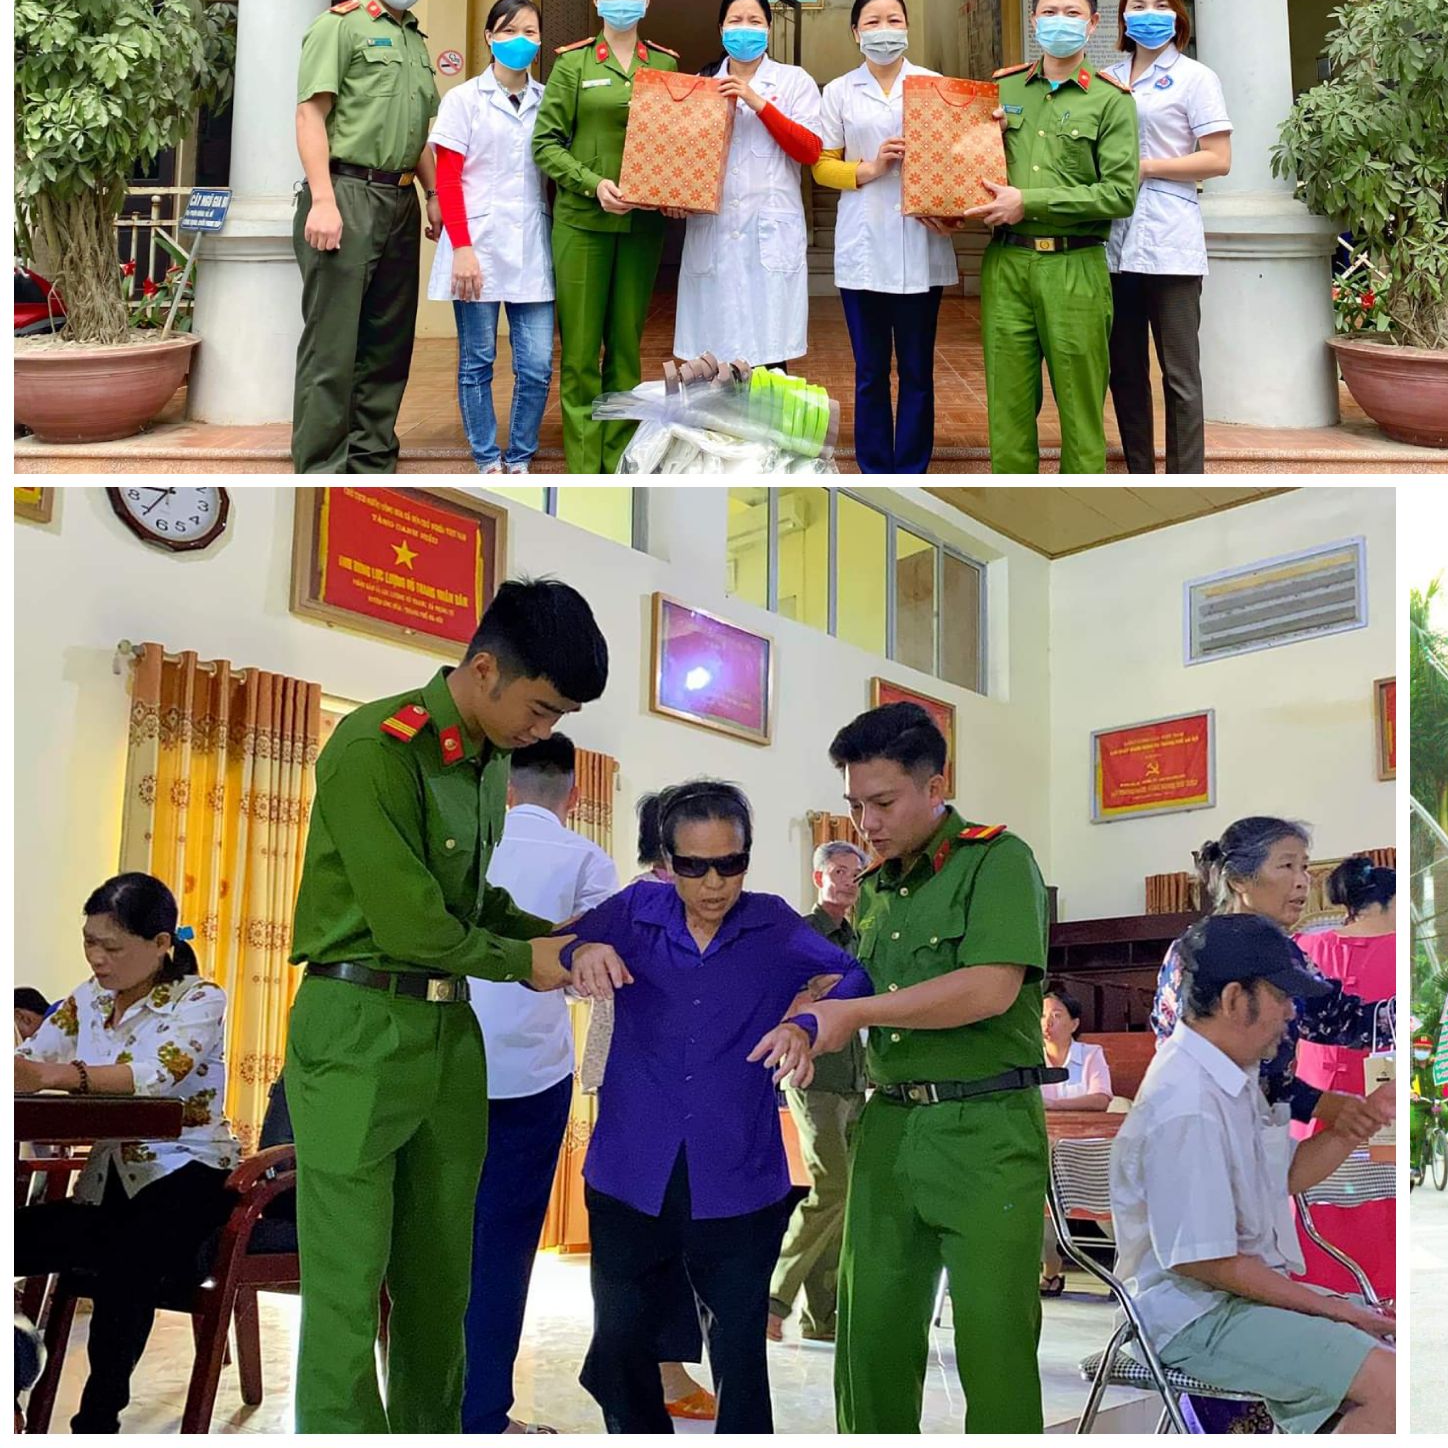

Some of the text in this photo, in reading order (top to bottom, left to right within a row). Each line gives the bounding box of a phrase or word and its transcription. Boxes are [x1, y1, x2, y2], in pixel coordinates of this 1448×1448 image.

[128, 488, 140, 501] 8
[198, 500, 209, 513] 3
[156, 518, 168, 531] 6
[175, 520, 186, 533] 5
[188, 515, 200, 526] 4
